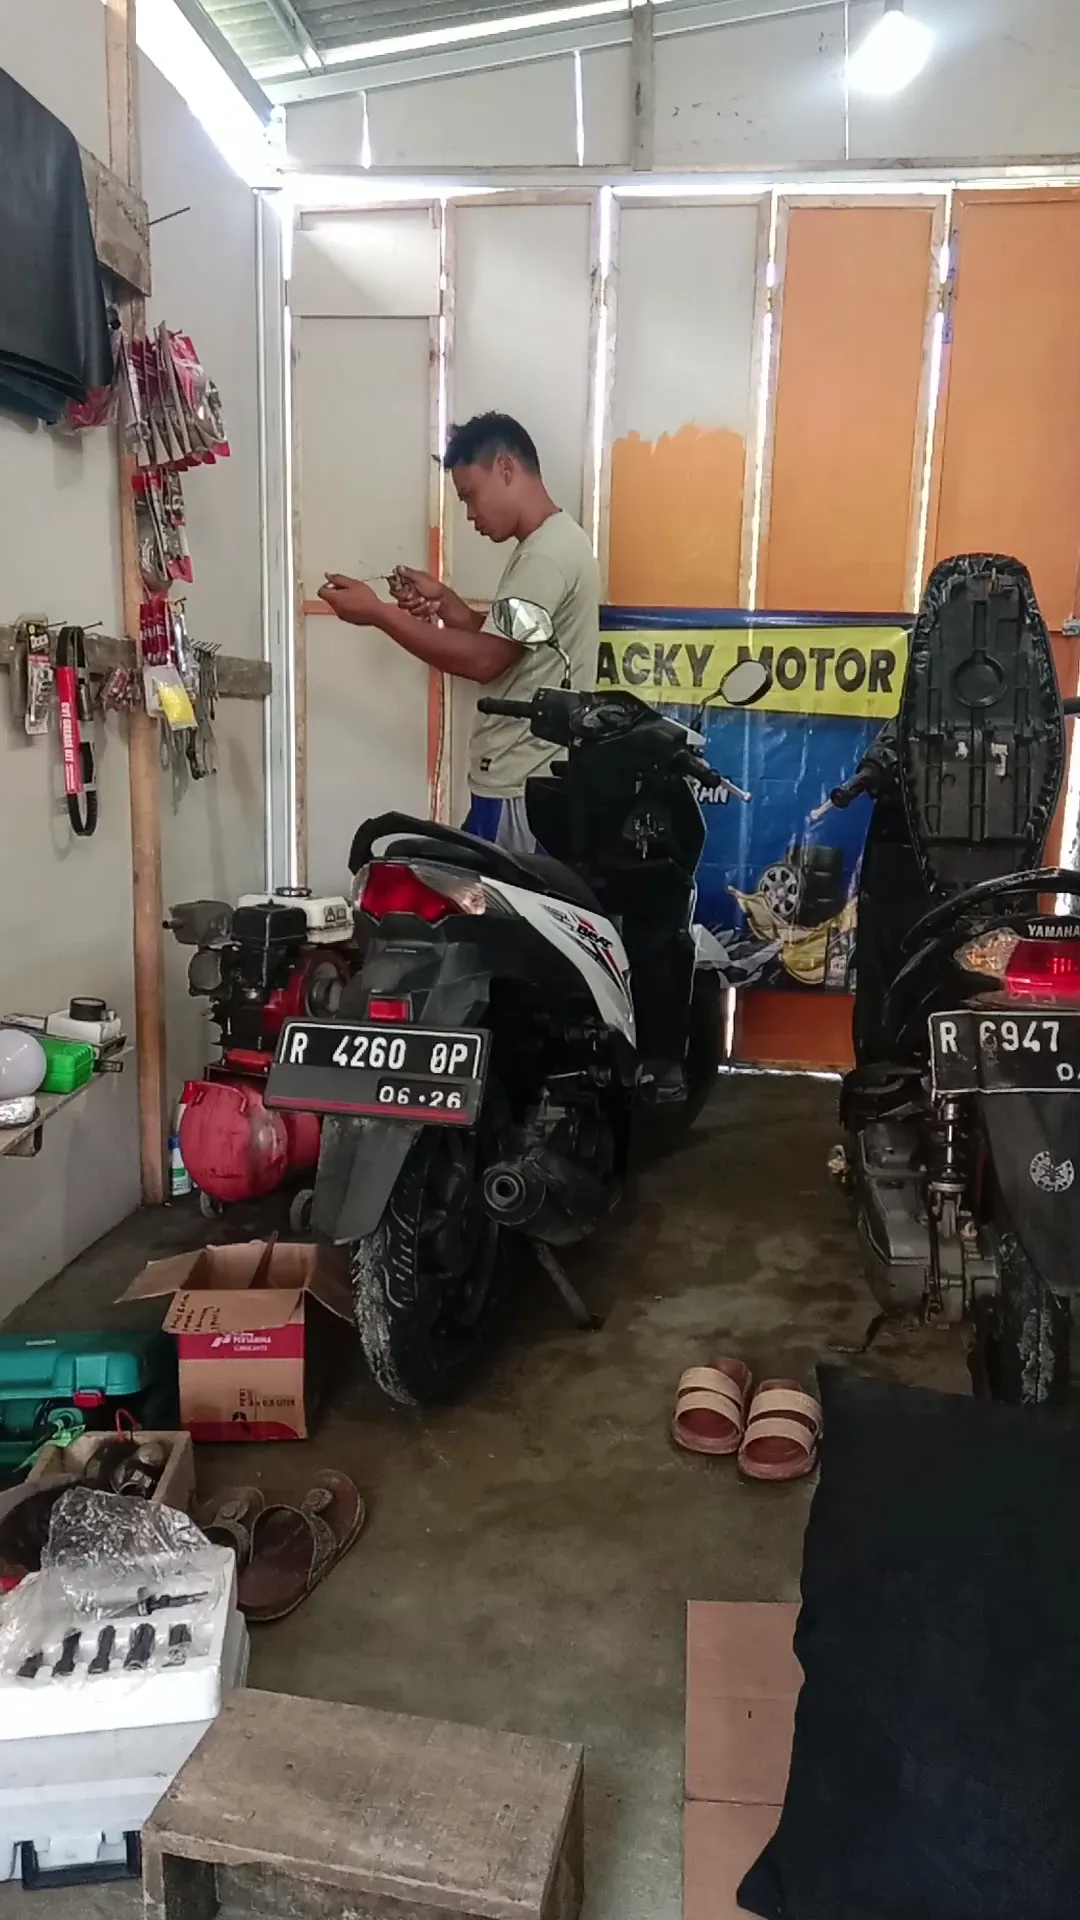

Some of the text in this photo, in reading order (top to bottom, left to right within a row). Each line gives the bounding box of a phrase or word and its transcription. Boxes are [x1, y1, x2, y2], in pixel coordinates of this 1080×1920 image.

[1027, 924, 1080, 938] YAMAHA
[940, 1020, 1060, 1053] R 6947
[290, 1033, 307, 1064] R
[332, 1035, 407, 1069] 4260
[1056, 1063, 1080, 1082] 0
